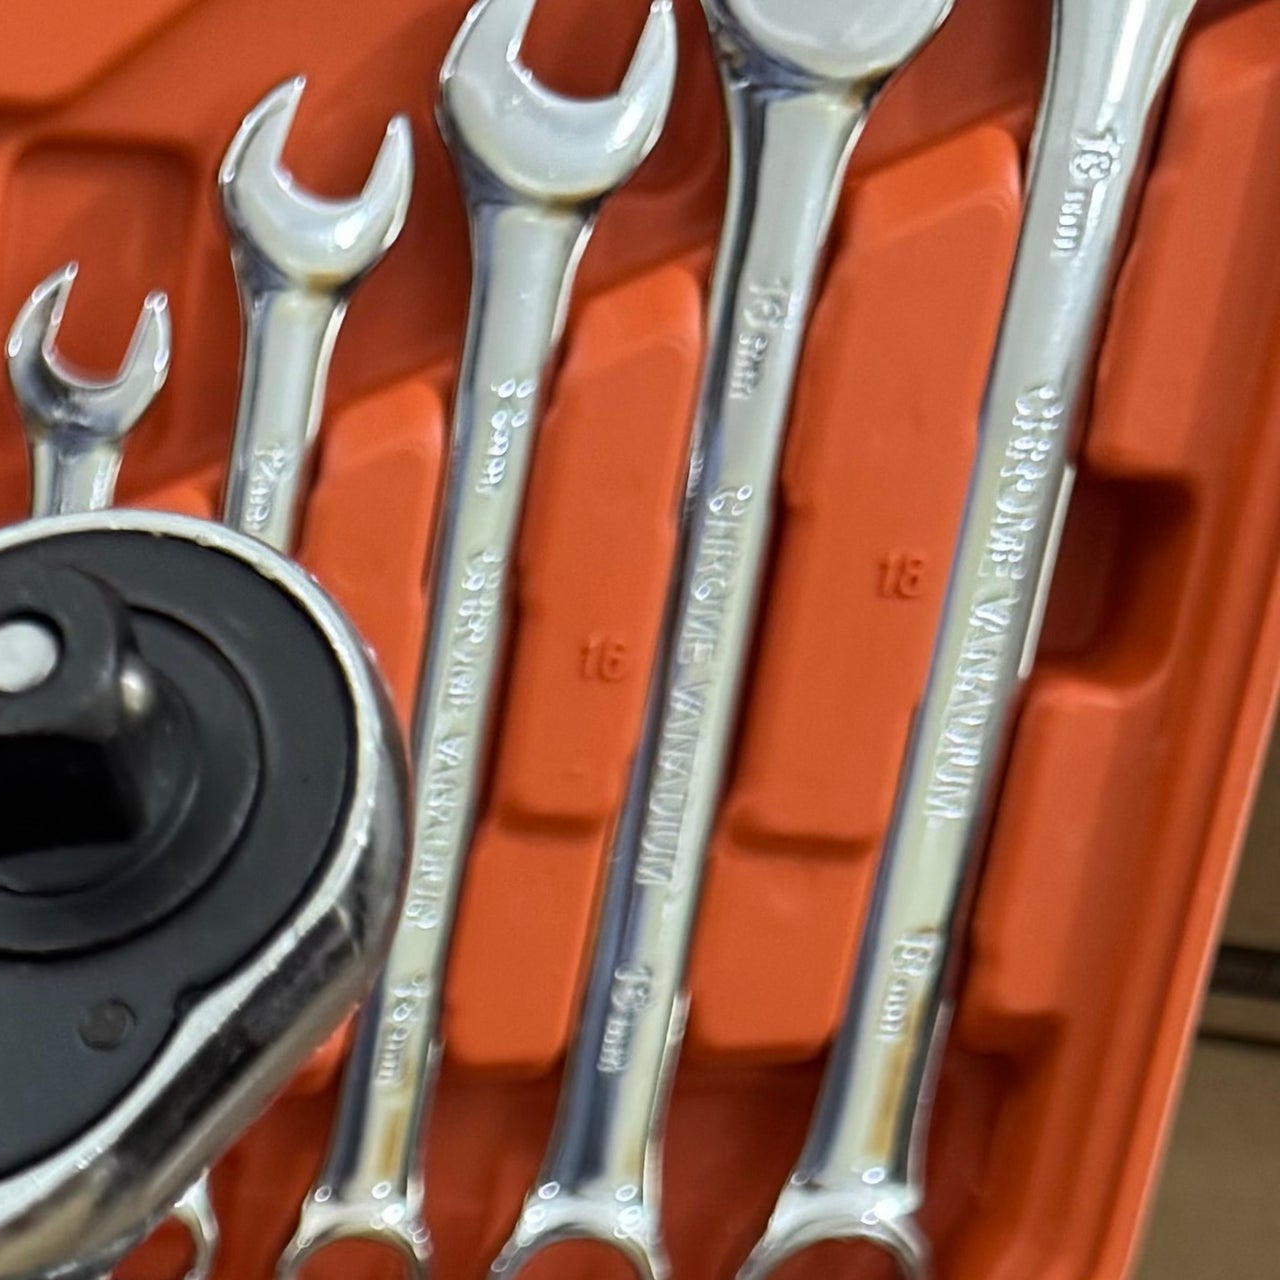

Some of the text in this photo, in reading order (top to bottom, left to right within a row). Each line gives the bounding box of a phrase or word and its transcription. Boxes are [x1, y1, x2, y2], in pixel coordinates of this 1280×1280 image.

[635, 483, 756, 888] CHROME VANADIUM
[923, 382, 1062, 823] CHROME VANADIUM
